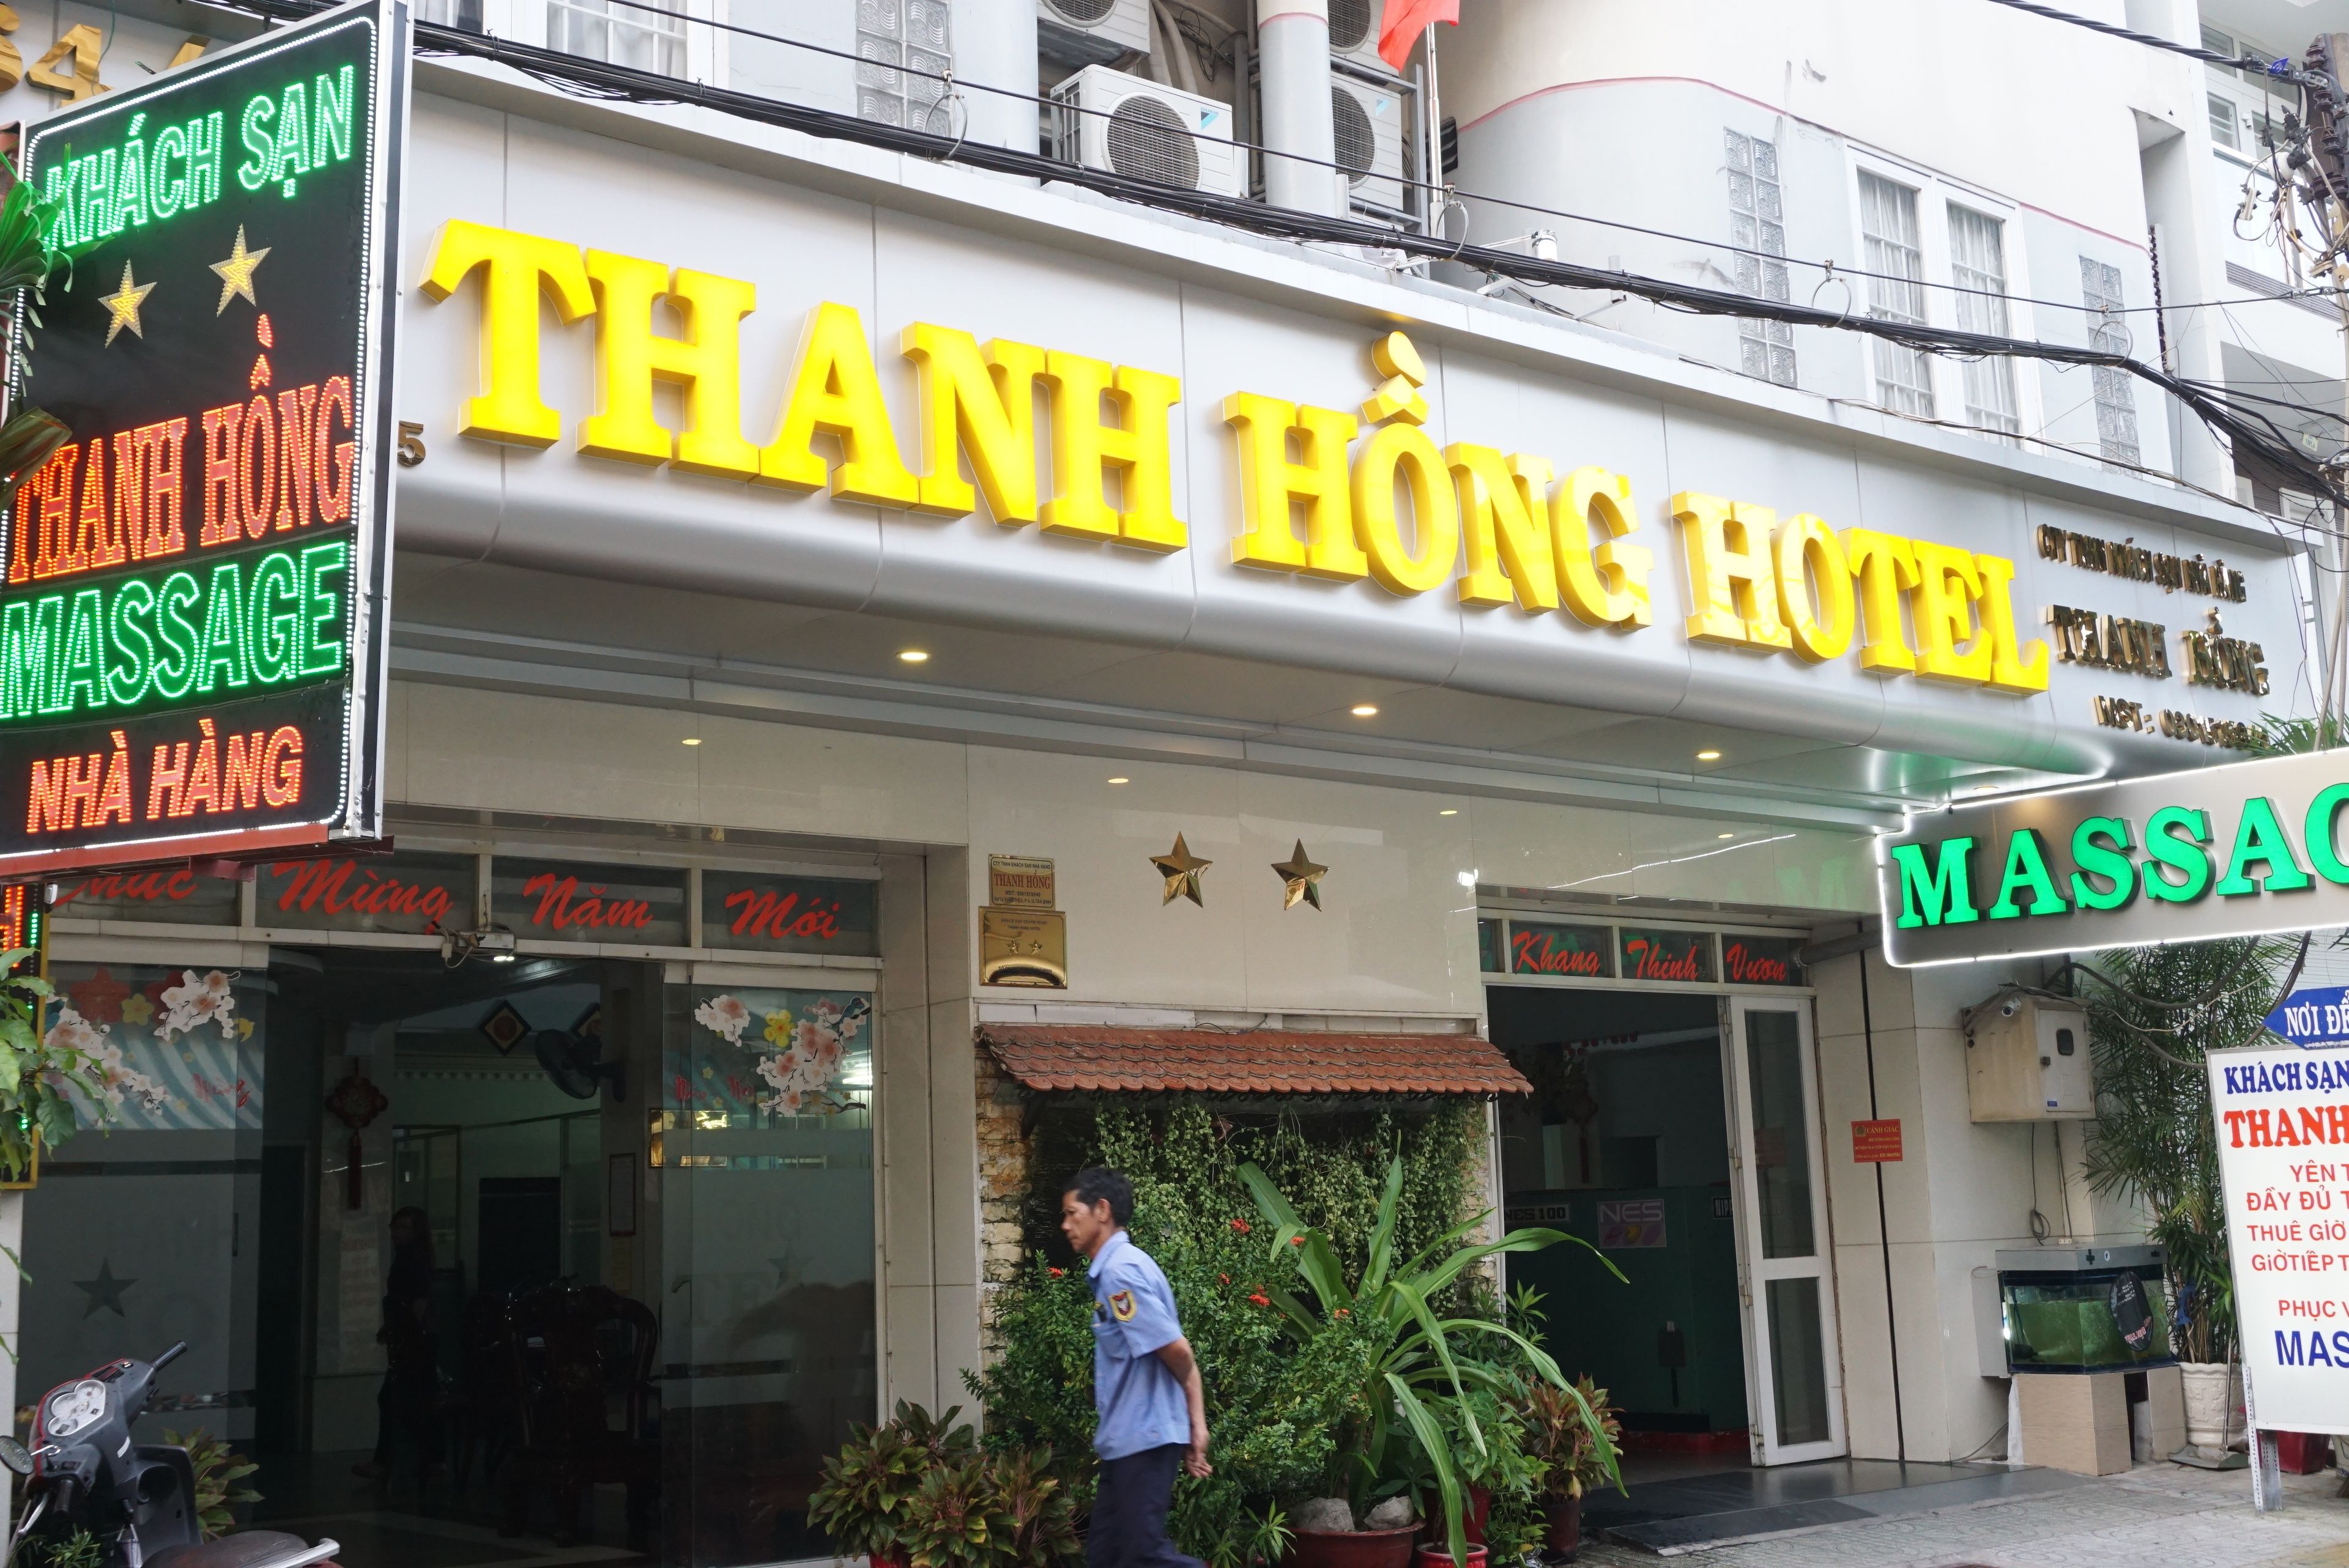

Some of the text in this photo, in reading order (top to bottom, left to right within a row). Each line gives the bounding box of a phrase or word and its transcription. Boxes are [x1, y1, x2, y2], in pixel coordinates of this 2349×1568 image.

[42, 65, 354, 253] KHÁCH SẠN
[200, 313, 356, 547] HỒNG
[418, 218, 2049, 696] THANH HỒNG HOTEL
[0, 541, 347, 720] MASSAGE
[2046, 604, 2173, 680] THANH
[26, 717, 305, 834] NHÀ HÀNG
[271, 858, 454, 935] Mừng
[522, 873, 654, 930] Năm
[725, 889, 841, 939] Mới
[993, 869, 1051, 889] THANH HỒNG
[1512, 931, 1600, 978] Khang
[2284, 1000, 2321, 1037] NƠI
[2224, 1059, 2349, 1095] KHÁCH SẠN
[2224, 1104, 2349, 1148] THANH
[2290, 1159, 2336, 1183] YÊN
[1599, 1202, 1663, 1223] NES
[2247, 1186, 2291, 1211] ĐẦY
[2299, 1184, 2331, 1210] ĐỦ
[2247, 1220, 2303, 1241] THUÊ
[2278, 1300, 2337, 1322] PHỤC
